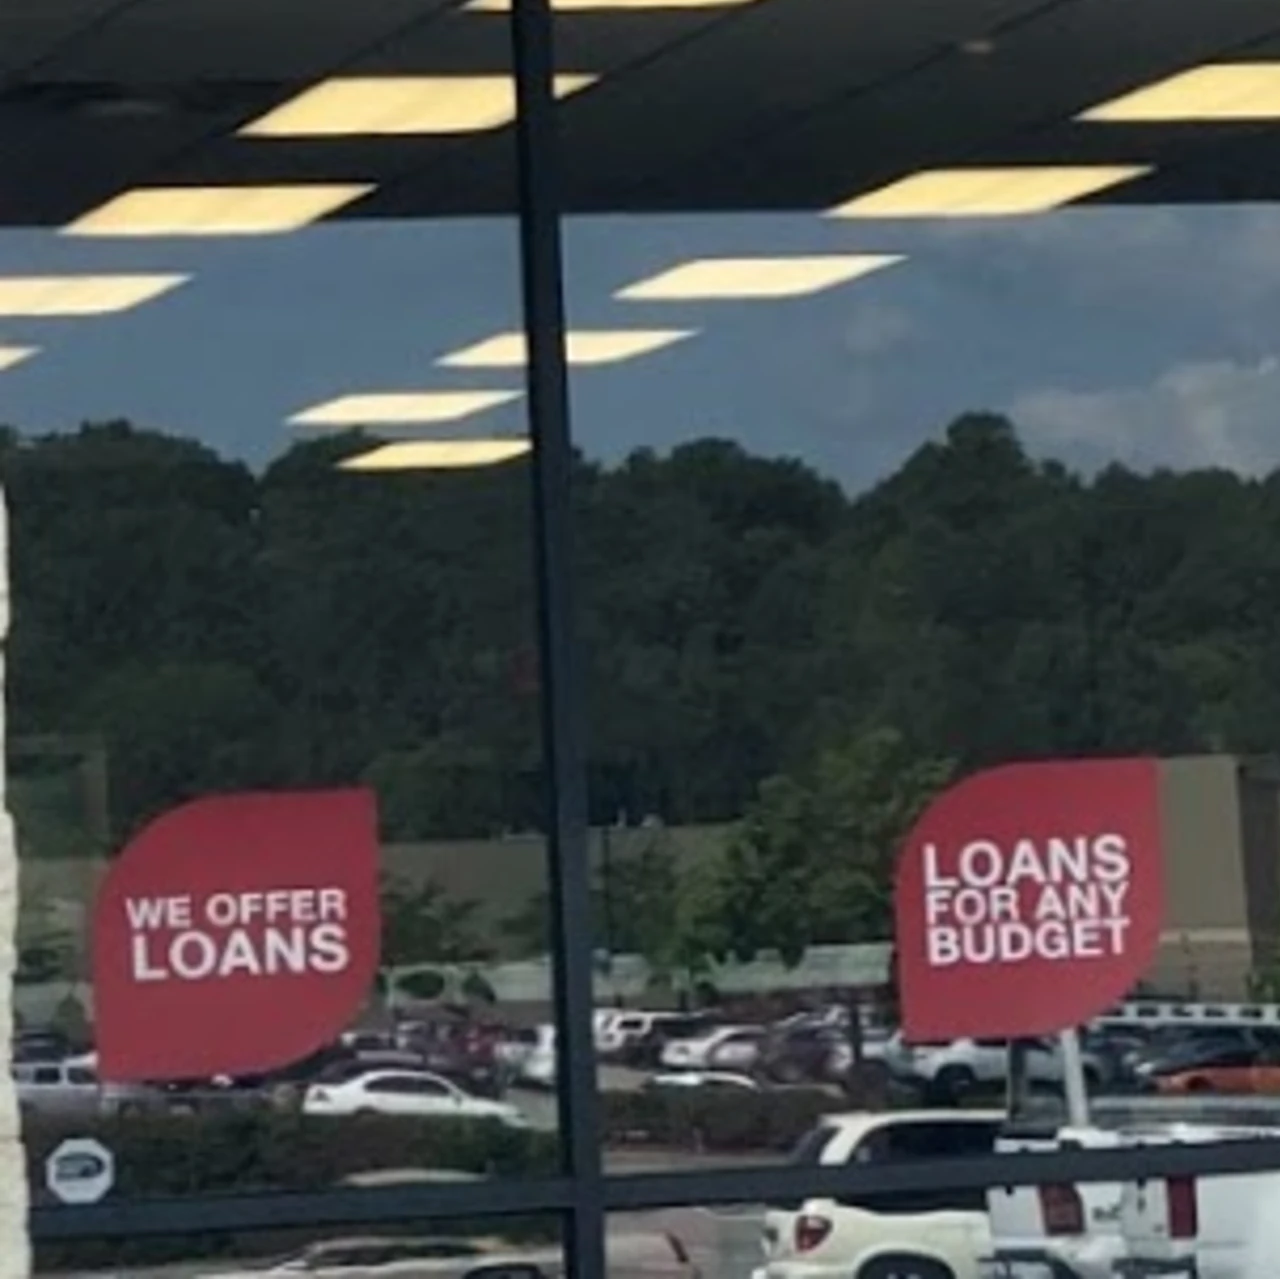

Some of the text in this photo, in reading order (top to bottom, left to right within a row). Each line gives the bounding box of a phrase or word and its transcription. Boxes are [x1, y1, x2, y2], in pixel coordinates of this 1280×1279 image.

[924, 834, 1129, 889] LOANS
[125, 888, 347, 929] WE OFFER
[926, 881, 1128, 925] FOR ANY
[132, 923, 350, 982] LOANS
[928, 917, 1131, 965] BUDGET
